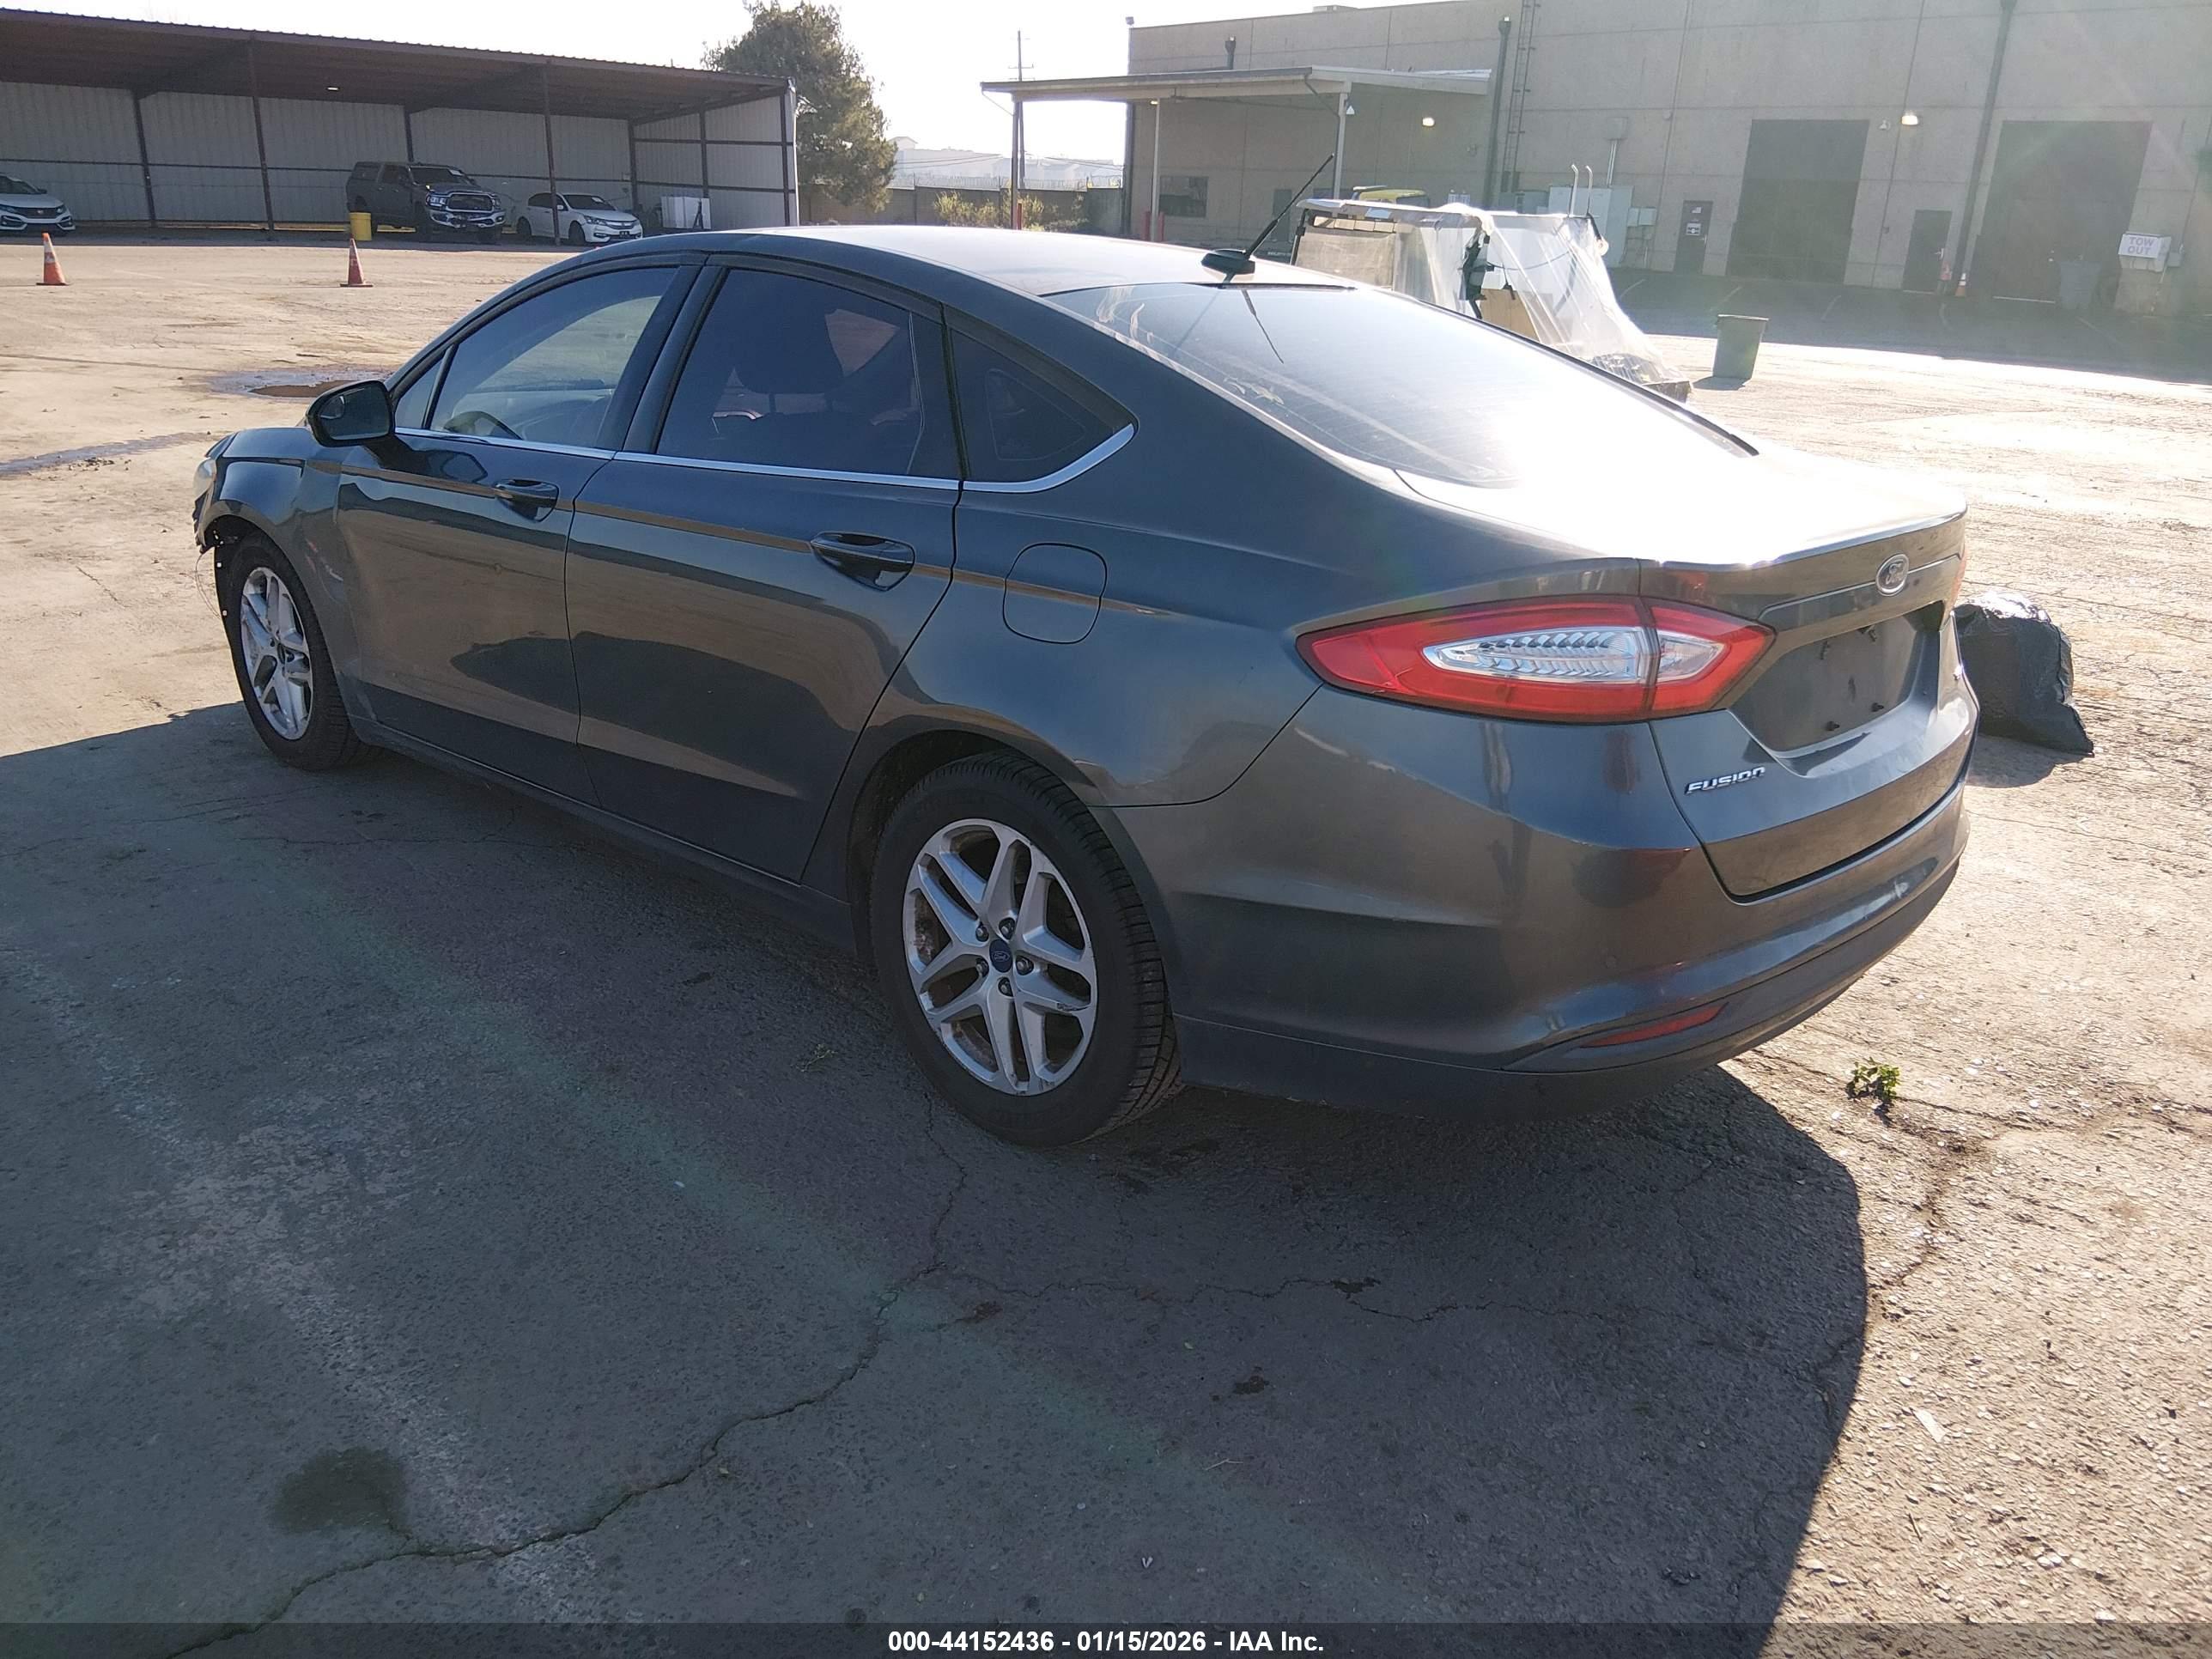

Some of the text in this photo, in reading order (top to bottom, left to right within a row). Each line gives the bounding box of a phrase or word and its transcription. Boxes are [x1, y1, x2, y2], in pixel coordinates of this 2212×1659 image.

[2129, 236, 2154, 247] TOW
[2128, 246, 2151, 255] OUT
[1684, 766, 1766, 795] FUSION
